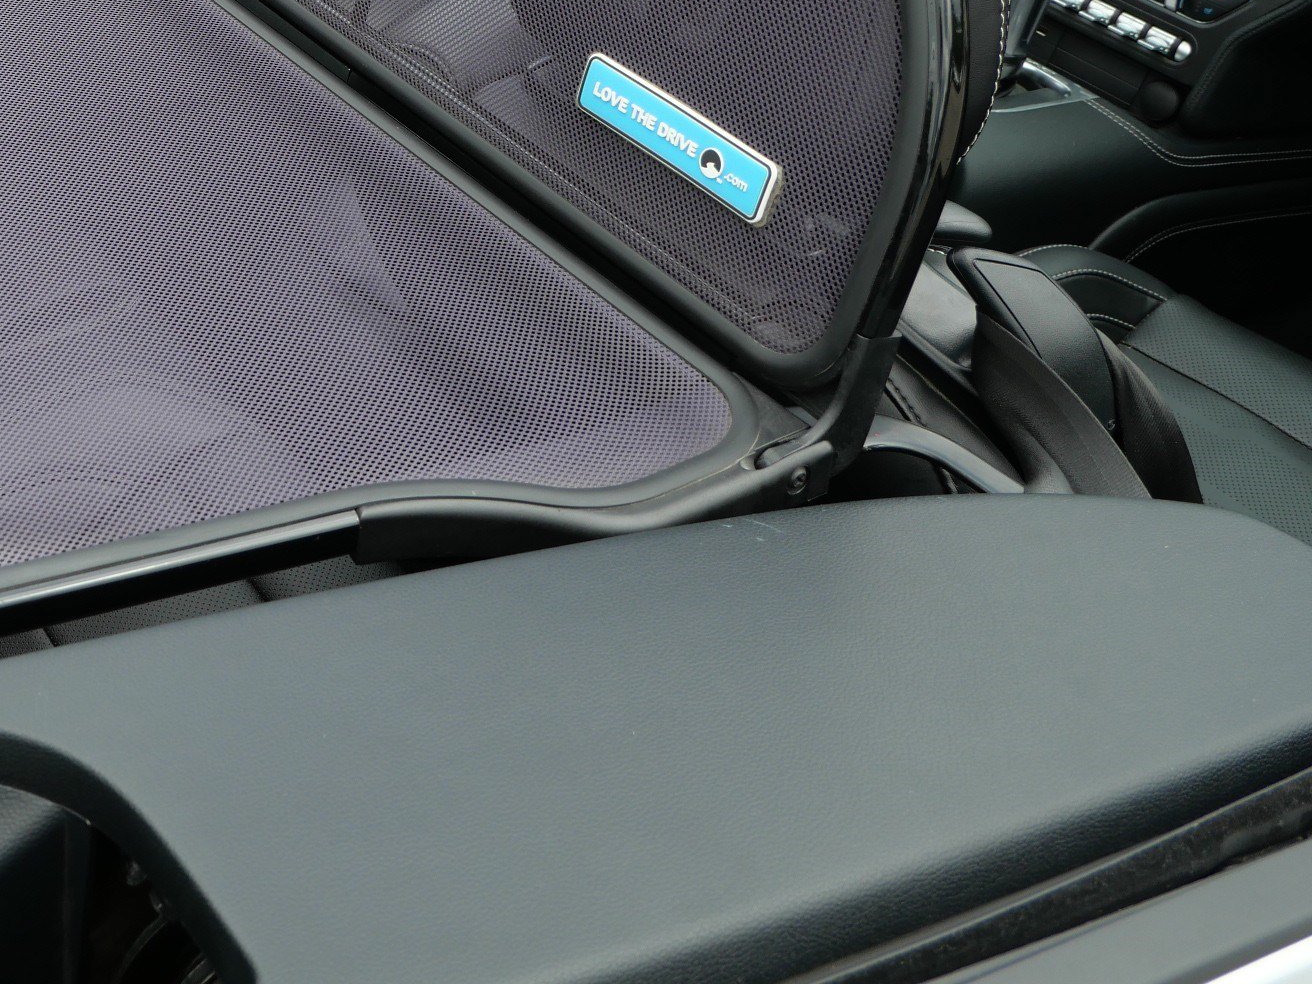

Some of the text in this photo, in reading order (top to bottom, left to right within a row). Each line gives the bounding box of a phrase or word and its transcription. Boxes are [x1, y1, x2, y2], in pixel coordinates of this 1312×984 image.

[593, 81, 748, 192] LOVE THE DRIVE .com
